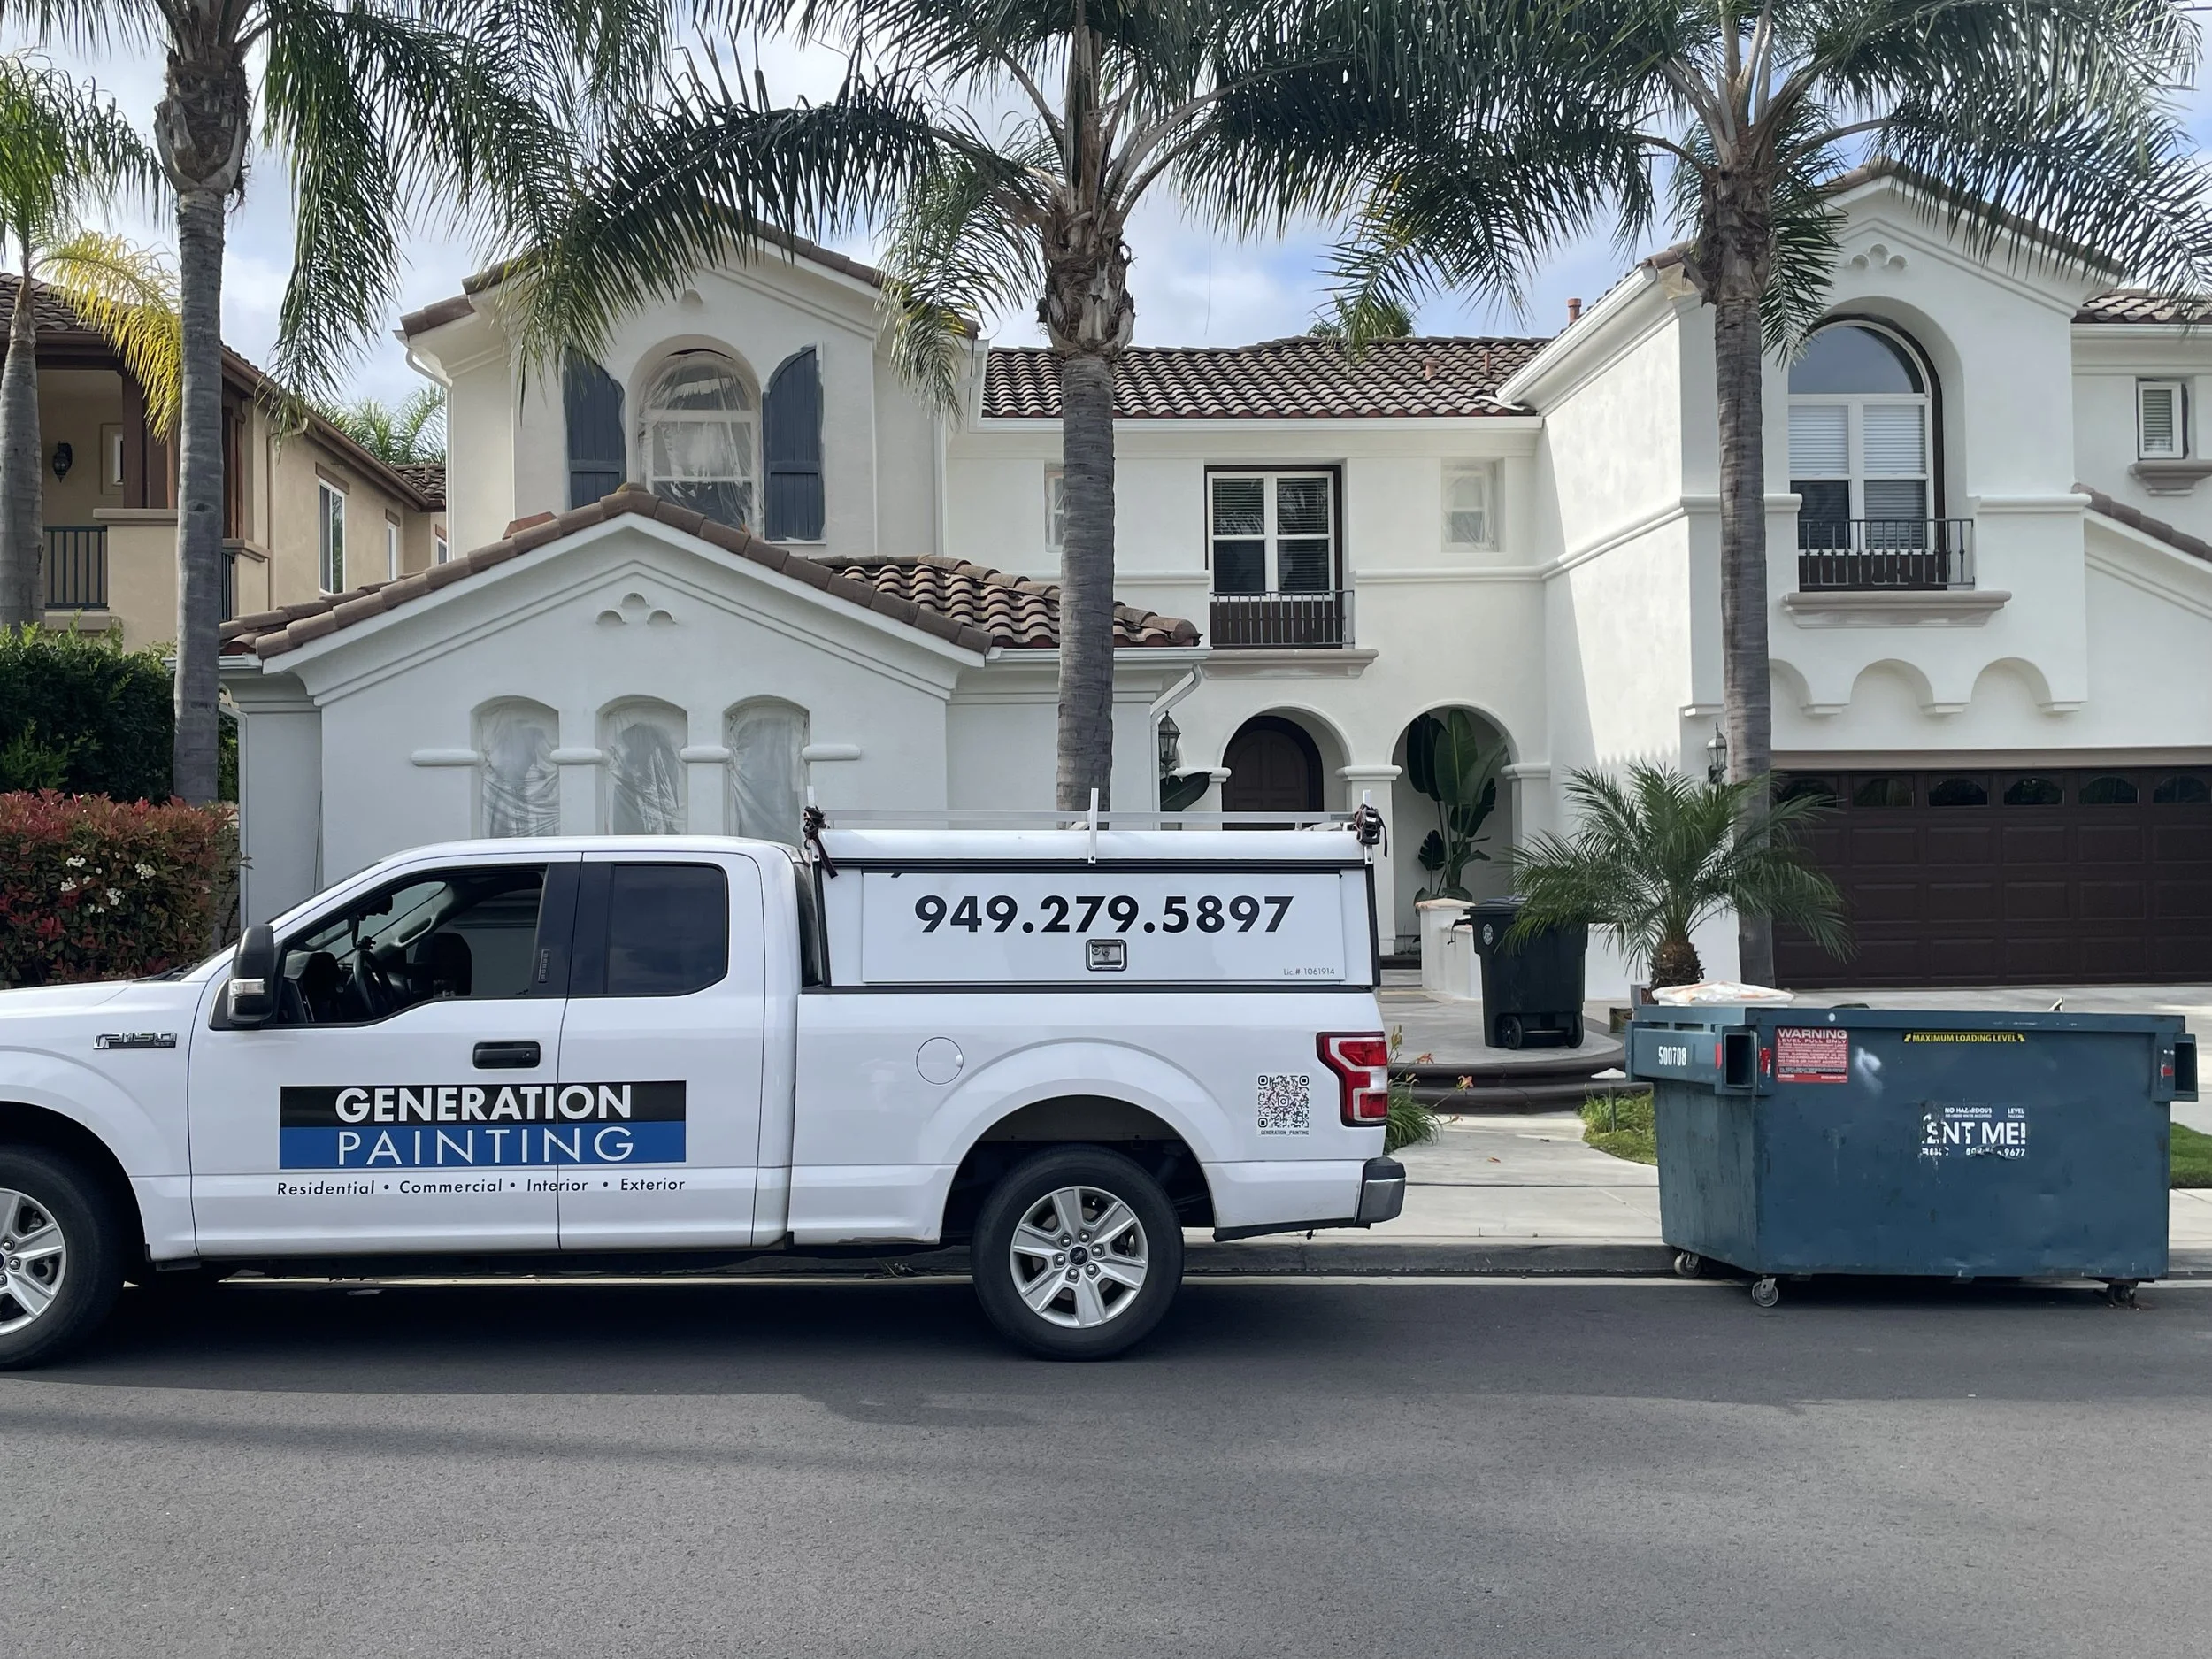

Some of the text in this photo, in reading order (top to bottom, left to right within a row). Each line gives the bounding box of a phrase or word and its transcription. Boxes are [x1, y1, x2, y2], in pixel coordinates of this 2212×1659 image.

[915, 895, 1294, 934] 949.279.5897
[1303, 967, 1335, 976] 1061914
[1778, 1028, 1847, 1039] WARNING
[1912, 1033, 2017, 1042] MAXIMUM LOADING LEVEL
[1658, 1045, 1687, 1066] 500708
[335, 1084, 631, 1124] GENERATION
[1981, 1121, 2026, 1145] ME!
[338, 1126, 634, 1166] PAINTING
[277, 1177, 686, 1196] Residential Commercial Interior Exterior
